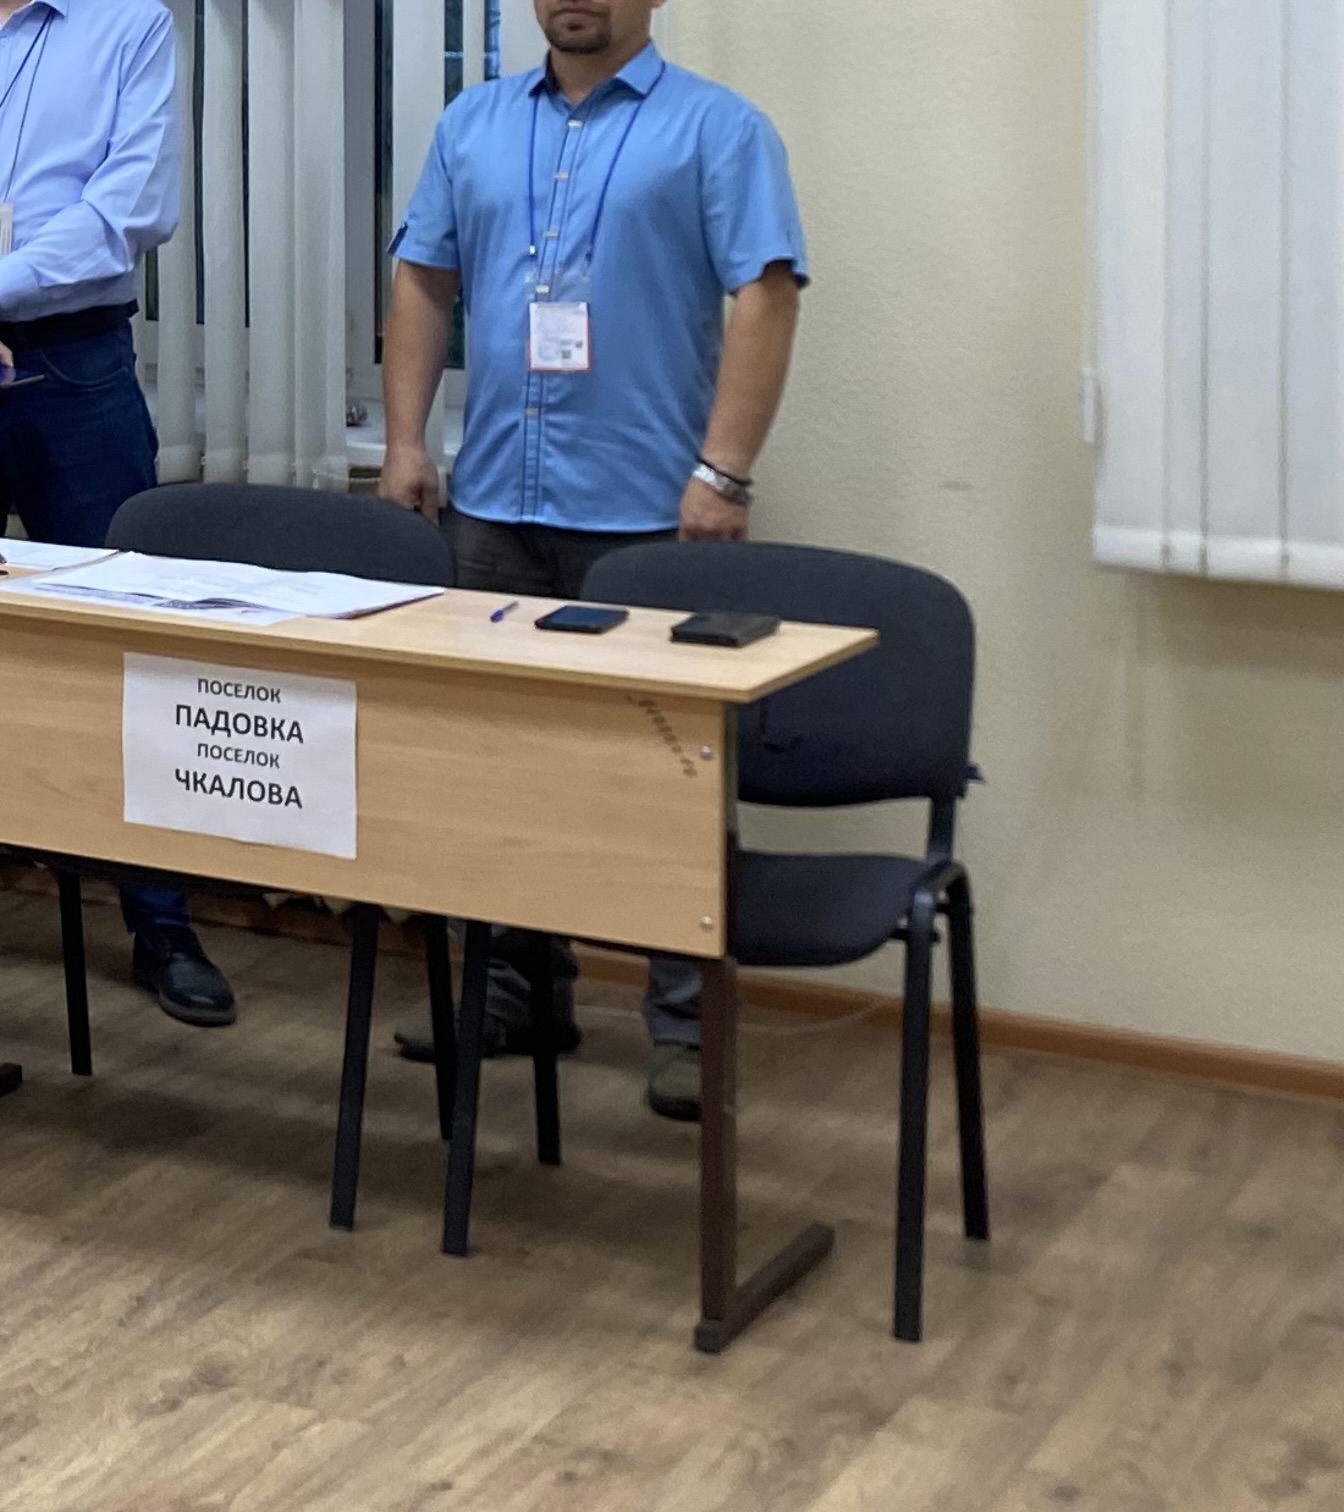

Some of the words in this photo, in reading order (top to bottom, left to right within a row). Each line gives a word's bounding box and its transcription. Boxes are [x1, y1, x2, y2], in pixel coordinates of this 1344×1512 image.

[197, 677, 281, 704] ПОСЕЛОК
[175, 703, 304, 744] ПАДОВКА
[197, 742, 280, 769] ПОСЕЛОК
[175, 768, 303, 809] ЧКАЛОВА
